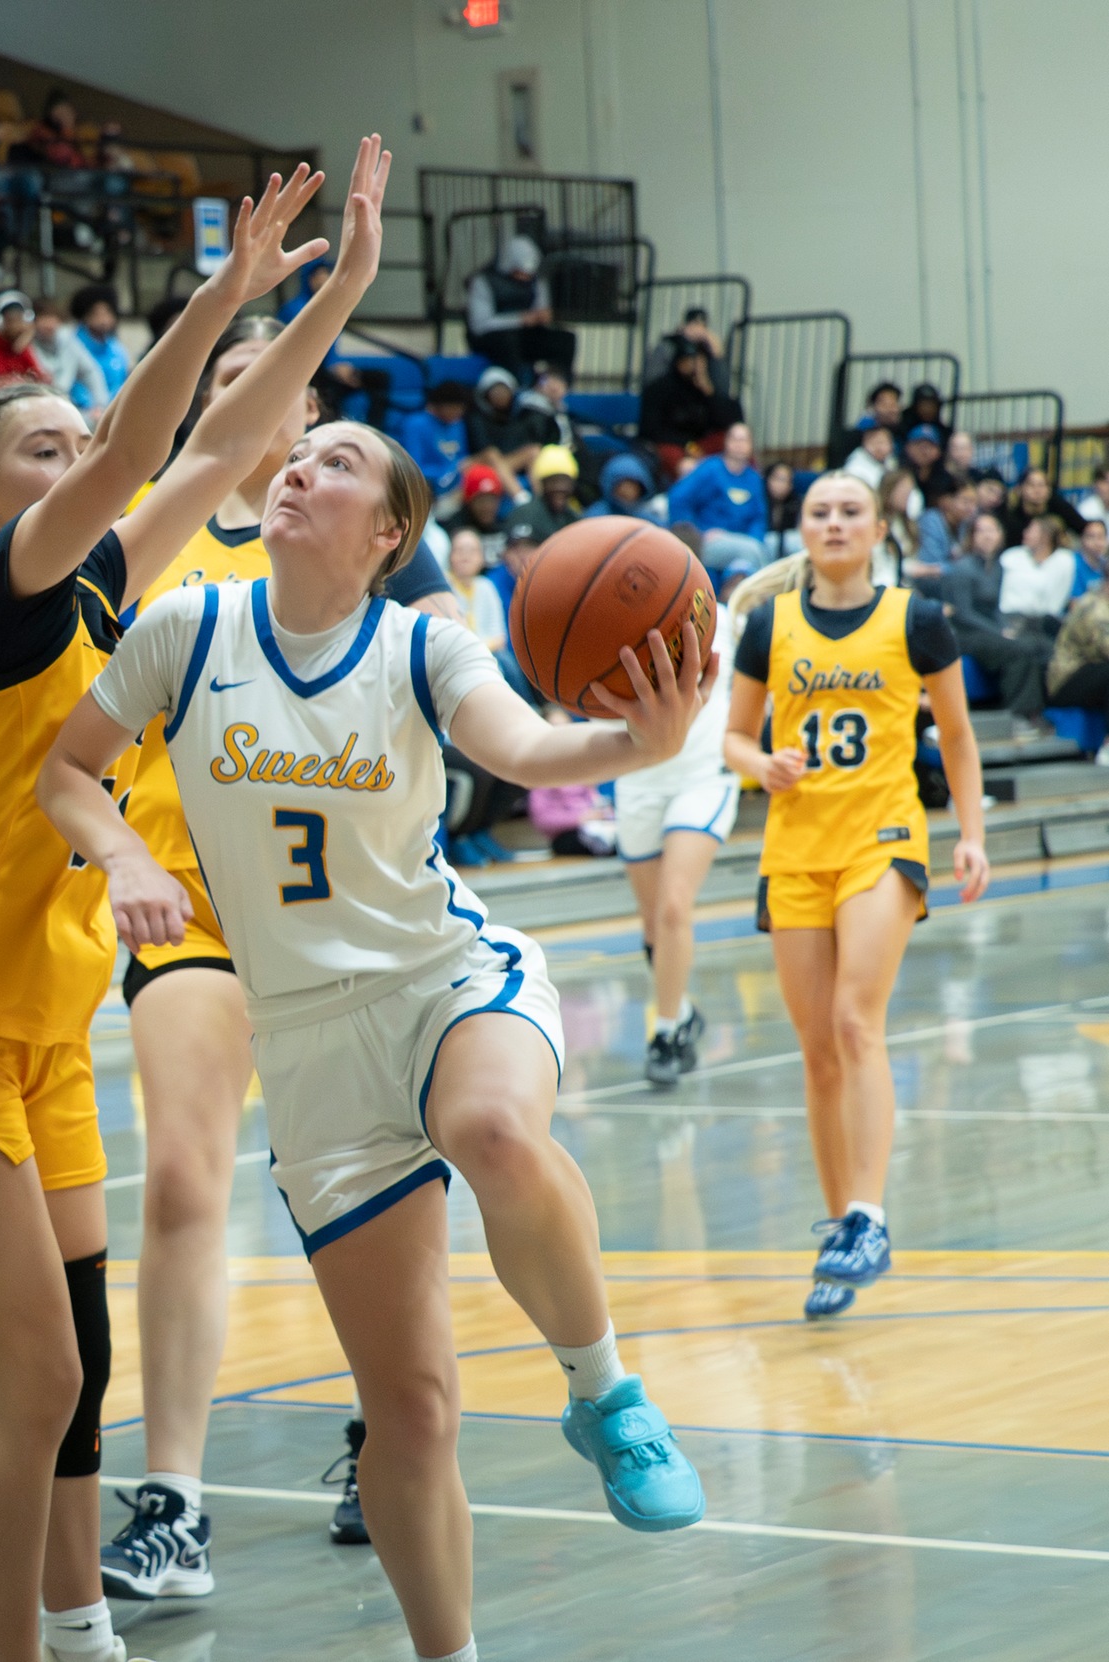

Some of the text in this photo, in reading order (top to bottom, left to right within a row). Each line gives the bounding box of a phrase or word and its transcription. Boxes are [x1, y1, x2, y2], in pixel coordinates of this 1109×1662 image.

[788, 657, 886, 700] Spires
[210, 722, 395, 792] Swedes
[799, 709, 869, 772] 13
[272, 806, 333, 907] 3
